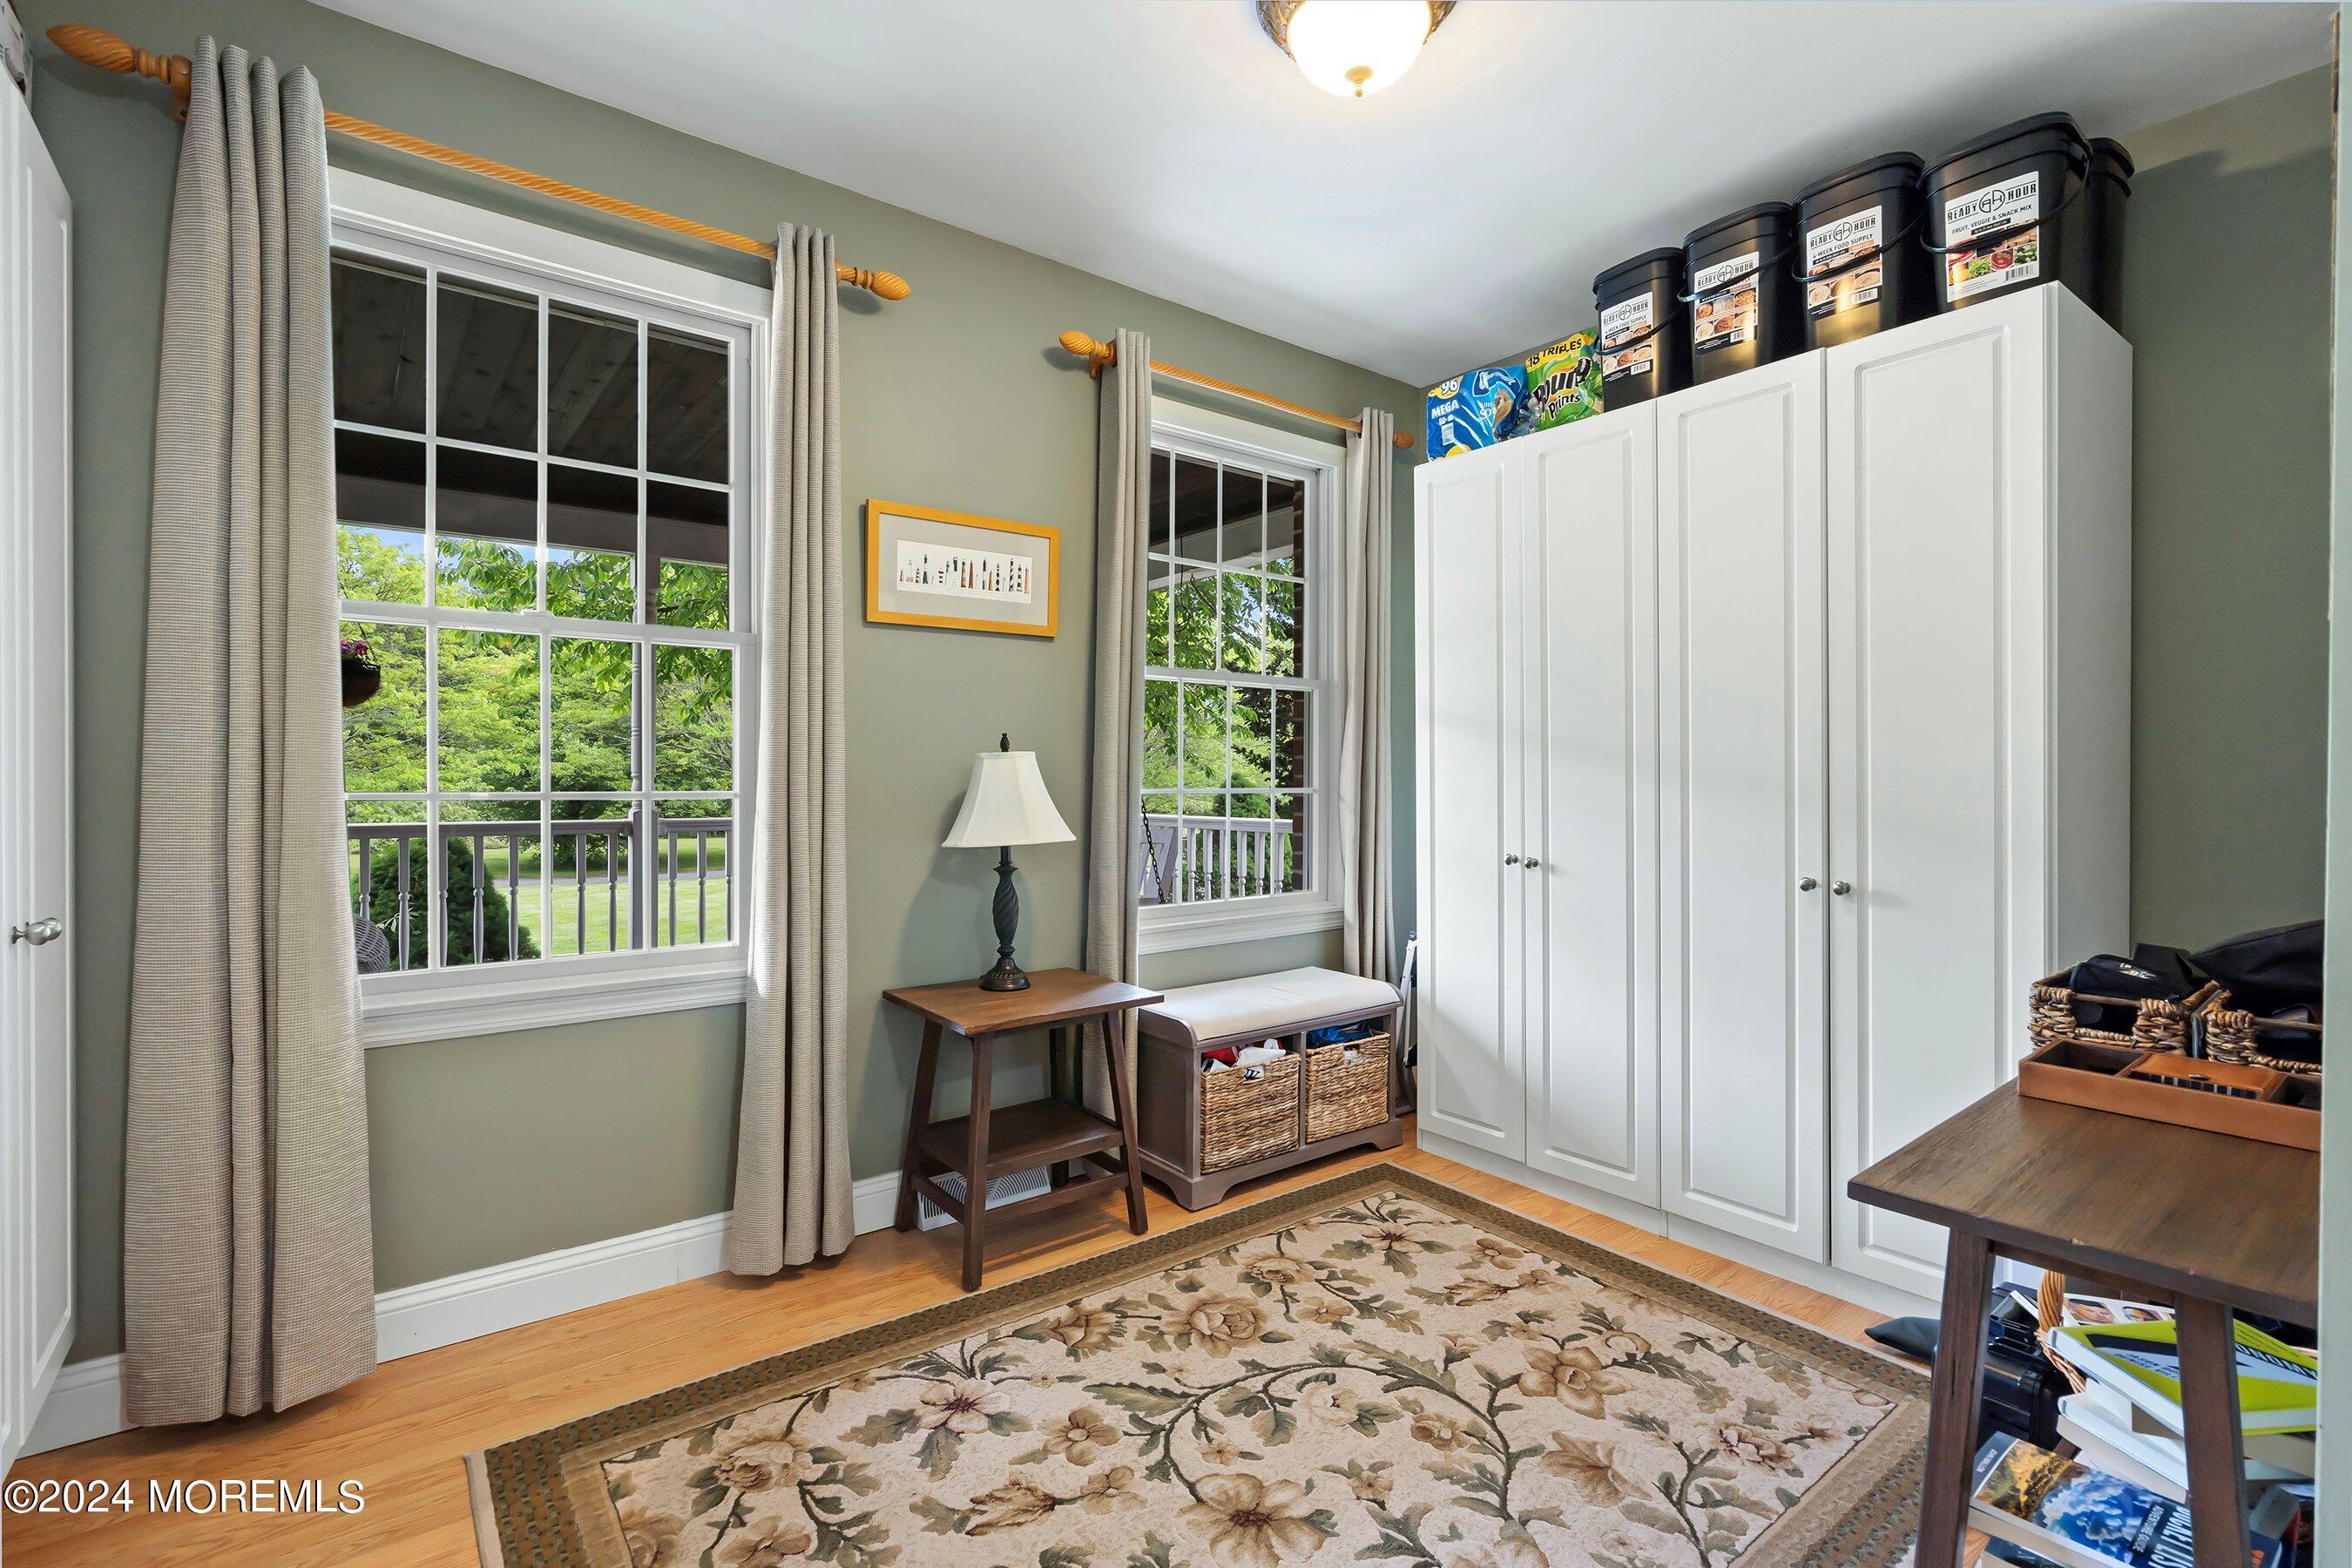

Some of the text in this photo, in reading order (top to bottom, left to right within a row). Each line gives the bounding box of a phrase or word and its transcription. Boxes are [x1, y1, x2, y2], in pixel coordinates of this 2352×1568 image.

[1947, 202, 1977, 221] READY
[2008, 183, 2037, 201] HOUR
[1970, 216, 1991, 228] VEGGIE
[1997, 207, 2018, 220] SNACK
[2019, 204, 2032, 213] MIX
[1810, 233, 1833, 248] READY
[1854, 217, 1876, 231] HOUR
[1835, 241, 1849, 251] FOOD
[1850, 233, 1873, 245] SUPPLY
[1697, 274, 1716, 287] READY
[1734, 261, 1754, 274] HOUR
[1441, 377, 1459, 395] 96
[1431, 400, 1460, 420] MEGA
